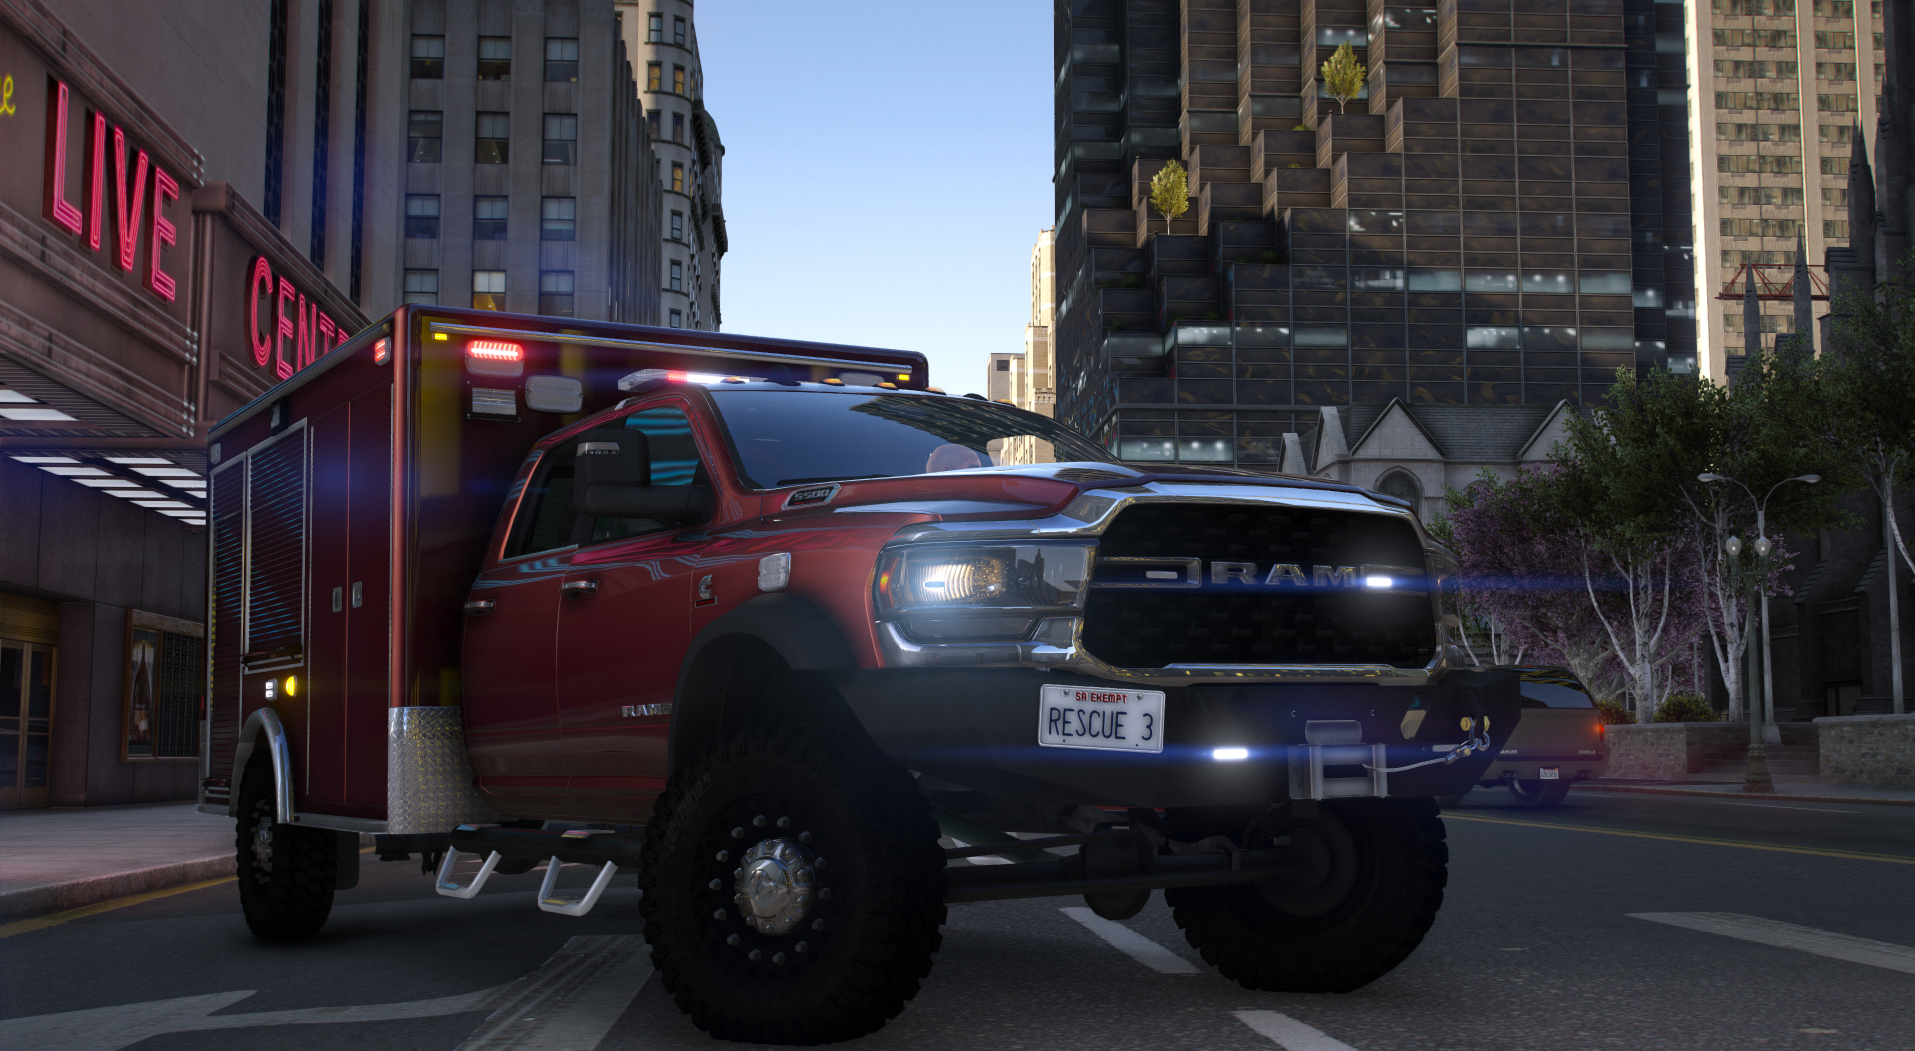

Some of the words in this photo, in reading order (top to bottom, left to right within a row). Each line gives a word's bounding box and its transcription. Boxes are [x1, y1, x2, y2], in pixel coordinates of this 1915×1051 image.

[53, 80, 179, 301] LIVE
[793, 489, 830, 501] 5500
[1211, 561, 1357, 588] RAM
[1076, 691, 1088, 702] SA
[1090, 692, 1128, 704] EXEMPT
[1048, 706, 1128, 740] RESCUE
[1141, 712, 1154, 741] 3
[663, 773, 713, 854] 245/70R19.5
